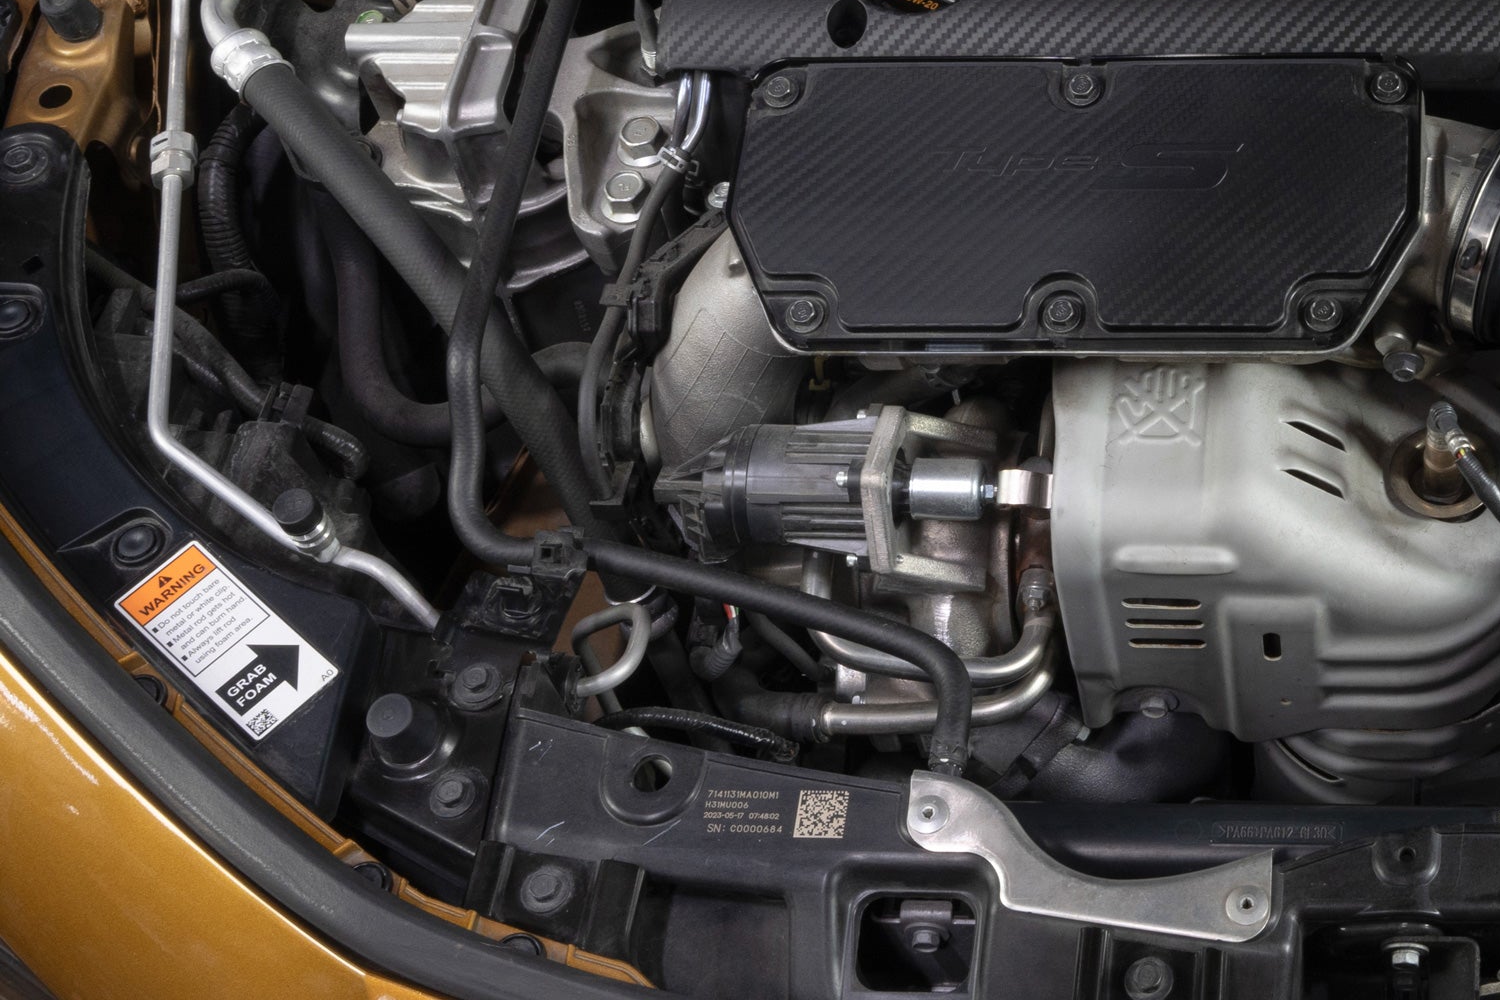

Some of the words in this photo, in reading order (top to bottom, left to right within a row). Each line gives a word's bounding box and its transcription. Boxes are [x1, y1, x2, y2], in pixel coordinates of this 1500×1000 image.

[931, 147, 1099, 176] Type
[139, 563, 206, 617] WARNING
[158, 619, 170, 629] Do
[170, 608, 183, 619] not
[182, 592, 203, 610] touch
[202, 580, 219, 593] bare
[166, 618, 187, 636] metal
[195, 596, 215, 613] white
[215, 585, 230, 597] clip.
[172, 625, 194, 644] Metal
[194, 615, 207, 626] rod
[207, 603, 223, 616] gets
[222, 592, 236, 603] hot
[181, 637, 196, 650] and
[196, 626, 209, 638] can
[209, 612, 226, 626] burn
[188, 636, 214, 657] Always
[213, 626, 224, 636] lift
[223, 616, 236, 628] rod
[195, 647, 216, 664] using
[215, 632, 234, 647] foam
[234, 617, 253, 632] area.
[226, 663, 267, 698] GRAB
[236, 672, 277, 708] FOAM
[706, 824, 726, 833] SN:
[730, 824, 782, 833] C0000684
